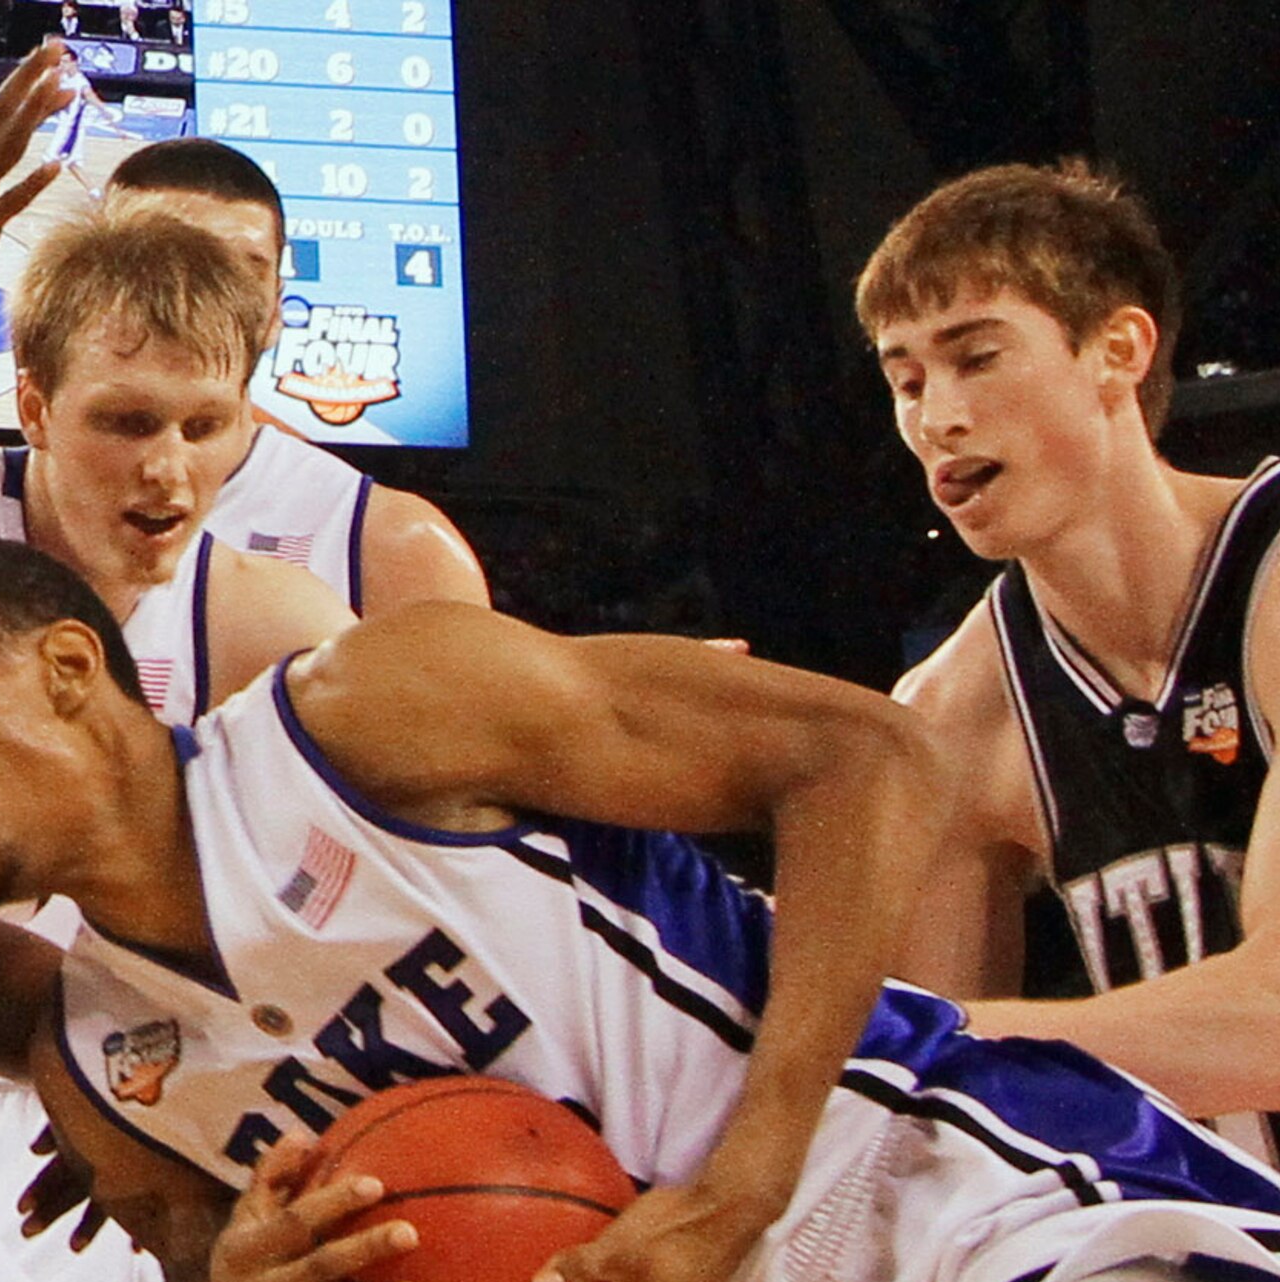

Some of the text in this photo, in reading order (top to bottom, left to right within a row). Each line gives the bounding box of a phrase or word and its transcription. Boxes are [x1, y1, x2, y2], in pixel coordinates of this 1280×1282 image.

[401, 1, 426, 33] 2
[207, 48, 431, 88] #20 6 0
[208, 103, 271, 138] #21
[329, 109, 354, 142] 2
[403, 113, 434, 146] 0
[322, 163, 435, 200] 10 2
[389, 223, 452, 243] T.O.L.
[403, 250, 434, 285] 4
[308, 305, 399, 345] FINAL
[272, 327, 400, 382] FOUR
